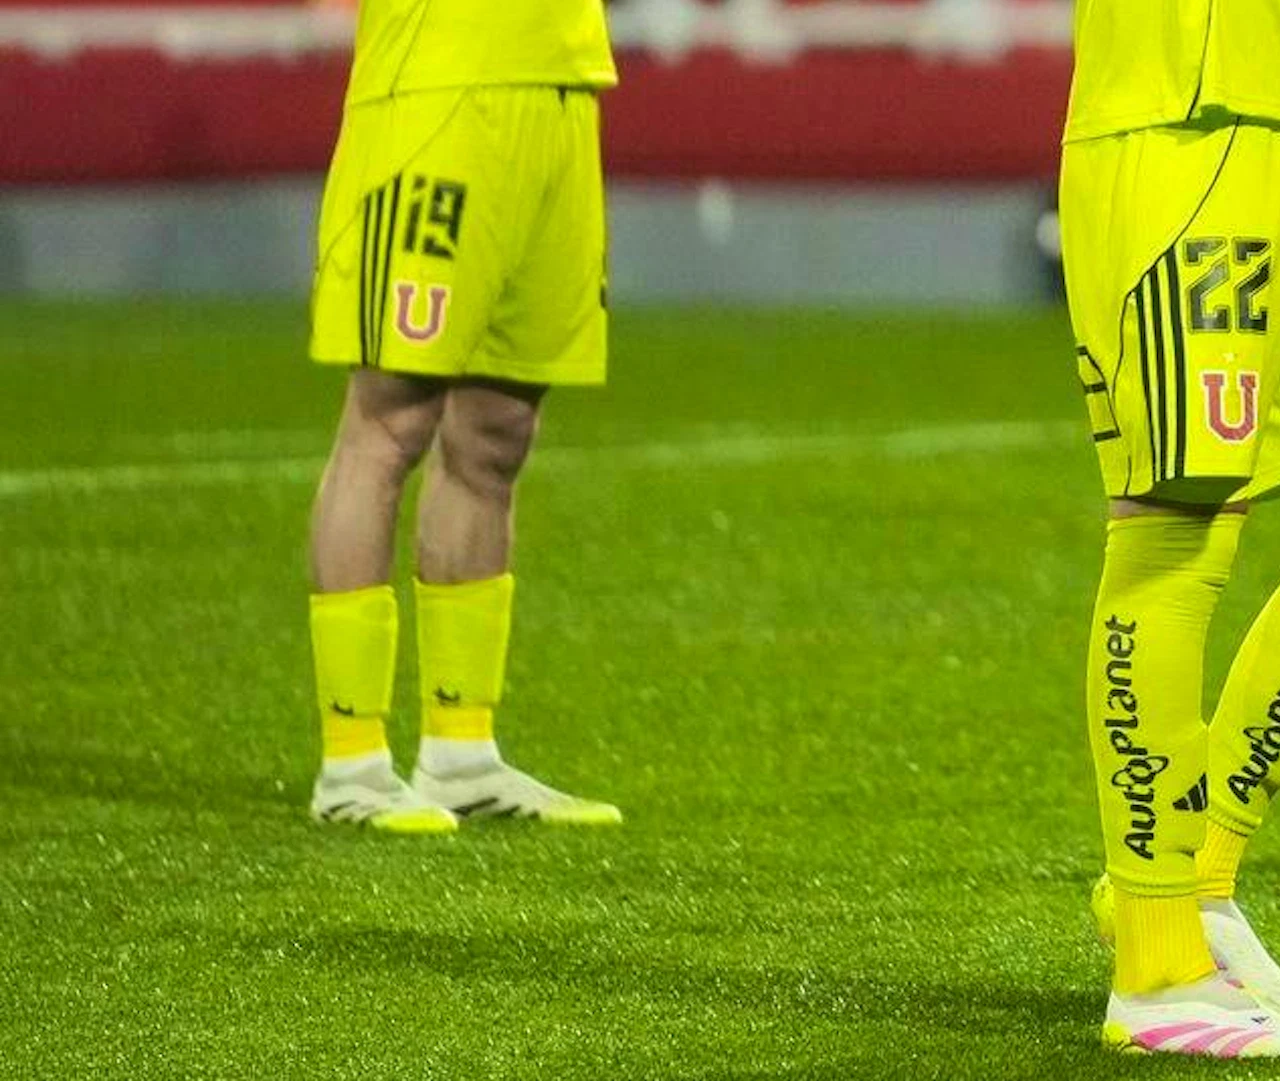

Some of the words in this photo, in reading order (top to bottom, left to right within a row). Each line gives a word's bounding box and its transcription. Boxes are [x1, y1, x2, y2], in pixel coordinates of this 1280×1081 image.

[402, 174, 467, 260] 19
[395, 282, 449, 345] U
[1183, 236, 1272, 334] 22
[1200, 369, 1260, 447] U
